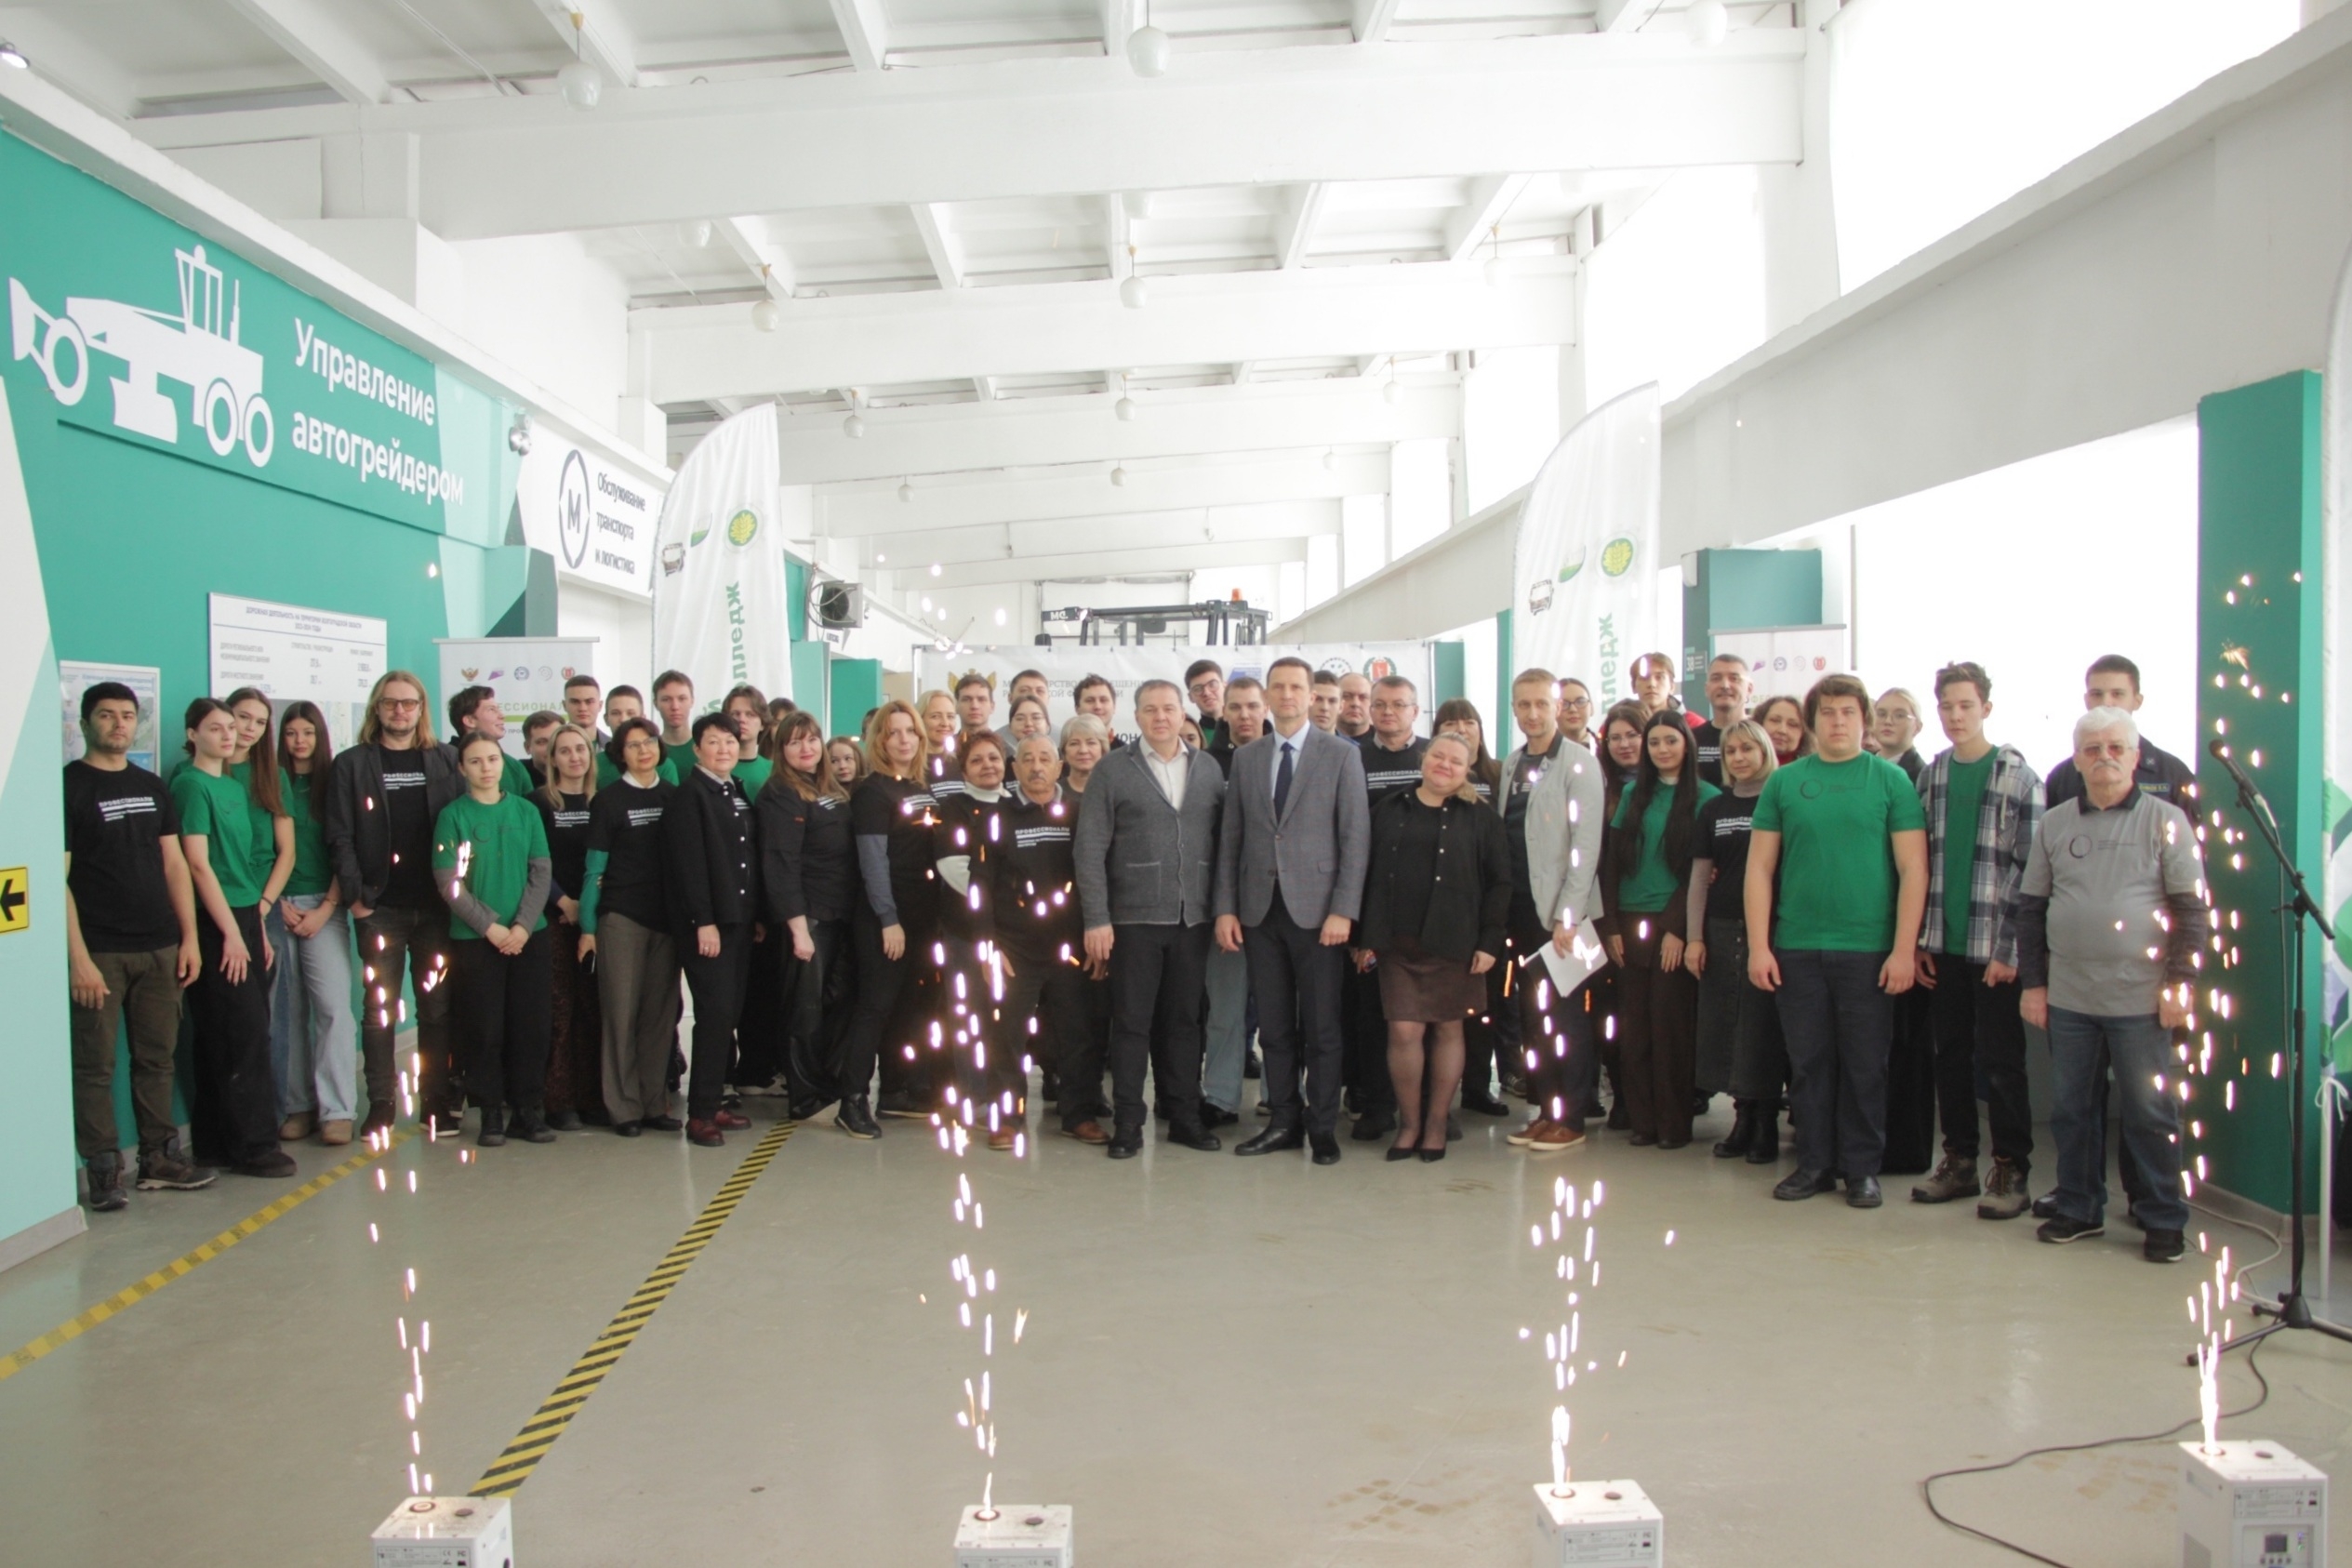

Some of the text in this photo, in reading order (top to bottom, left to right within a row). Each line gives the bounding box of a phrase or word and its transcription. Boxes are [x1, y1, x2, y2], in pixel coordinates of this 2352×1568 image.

[295, 317, 435, 426] Управление
[292, 411, 464, 506] автогрейдером
[597, 472, 646, 512] Обслуживание
[596, 512, 635, 542] транспорта
[595, 548, 635, 575] и логистика
